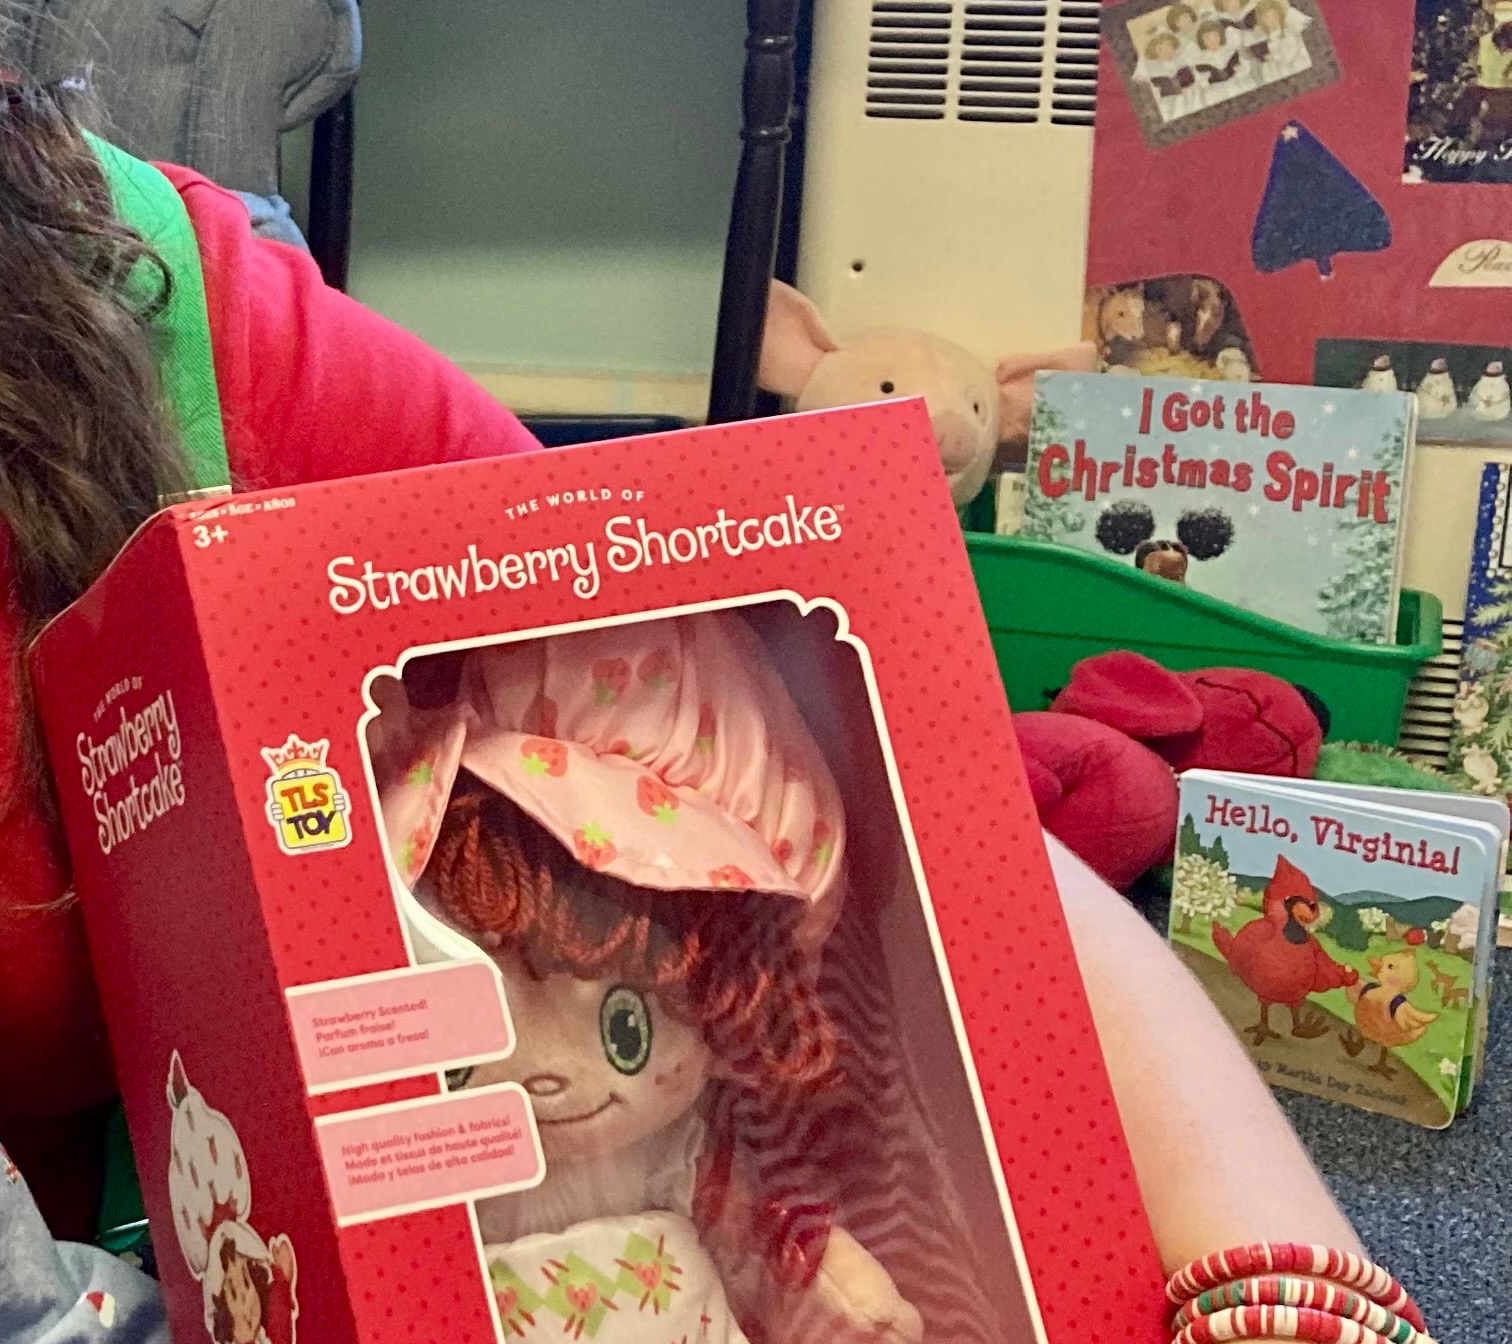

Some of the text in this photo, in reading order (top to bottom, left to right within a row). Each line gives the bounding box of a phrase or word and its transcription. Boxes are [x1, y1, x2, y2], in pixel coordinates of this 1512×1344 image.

[1138, 387, 1296, 440] I Got the
[1038, 439, 1392, 524] Christmas Spirit
[503, 488, 646, 522] THE WORLD OF
[191, 524, 229, 548] 3+
[326, 494, 843, 615] Strawberry Shortcake
[76, 688, 182, 797] Strawberry
[92, 751, 186, 856] Shortcake
[280, 782, 329, 813] TLS
[286, 809, 337, 840] TOY
[1204, 794, 1462, 876] Hello, Virginia!
[312, 998, 428, 1029] Strawberry Scented!
[316, 1019, 396, 1043] Parfum fraise!
[346, 1038, 385, 1053] aroma
[386, 1037, 395, 1046] a
[396, 1027, 430, 1044] fresa!
[341, 1114, 512, 1158] High quality fashion & fabrics!
[345, 1127, 523, 1172] Mode et tissus de haute qualité!
[388, 1169, 394, 1182] y
[396, 1161, 426, 1178] telas
[428, 1157, 442, 1172] de
[444, 1153, 469, 1169] alta
[470, 1144, 516, 1164] calidad!
